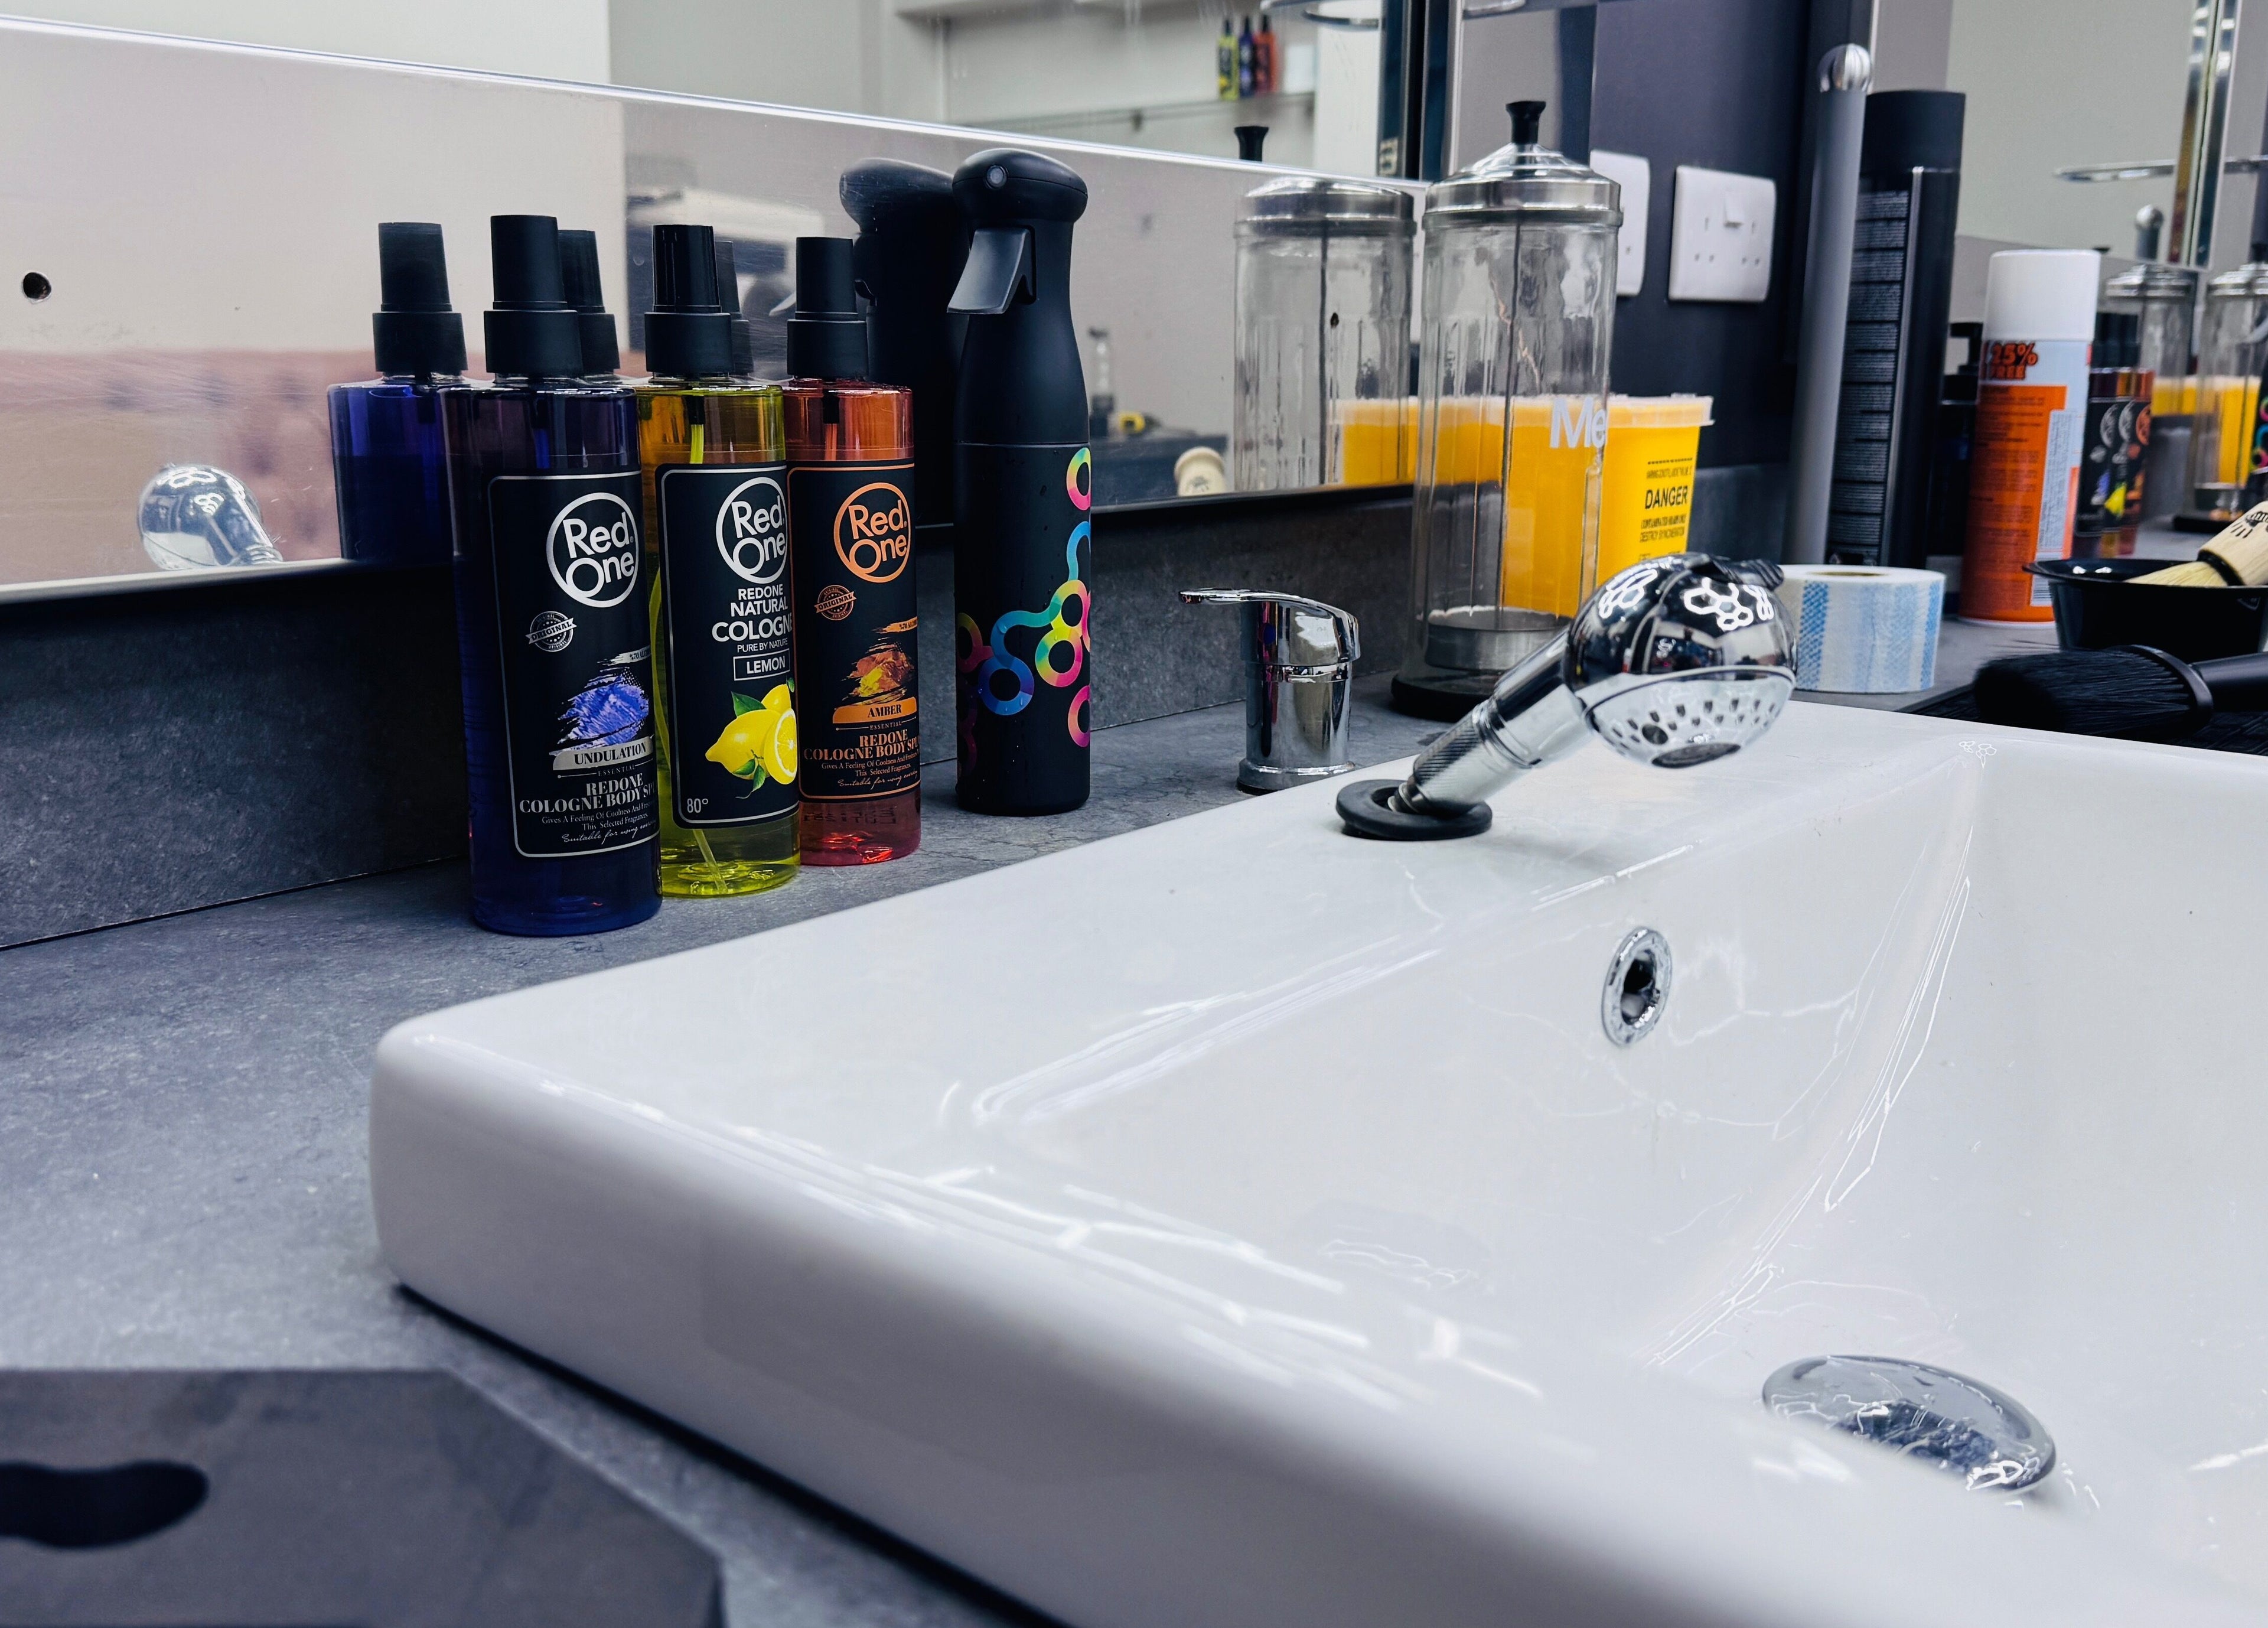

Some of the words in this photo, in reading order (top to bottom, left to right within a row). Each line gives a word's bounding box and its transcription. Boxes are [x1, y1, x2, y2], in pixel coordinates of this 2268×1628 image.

[1645, 486, 1688, 509] DANGER
[731, 495, 783, 538] Red
[848, 499, 904, 539] Red
[563, 512, 630, 558] Red
[732, 532, 786, 575] One
[849, 535, 907, 574] One
[565, 552, 634, 598] One
[738, 584, 783, 600] REDONE
[731, 596, 788, 617] NATURAL
[818, 594, 853, 610] ORIGINAL
[531, 621, 572, 640] ORIGINAL
[737, 643, 758, 653] PURE
[759, 642, 768, 650] BY
[769, 638, 788, 649] NATURE
[747, 656, 785, 674] LEMON
[867, 704, 902, 718] AMBER
[869, 721, 902, 730] ESSENTIAL
[859, 728, 908, 747] REDONE
[574, 742, 646, 765] UNDULATION
[804, 747, 873, 760] COLOGNE
[876, 741, 906, 757] BODY
[598, 764, 636, 776] ESSENTIAL
[845, 761, 866, 770] Feeling
[870, 766, 890, 776] Selected
[586, 773, 643, 796] REDONE
[838, 777, 871, 787] Suitable
[871, 776, 885, 790] for
[520, 796, 602, 813] COLOGNE
[606, 788, 641, 807] BODY
[571, 813, 594, 822] Feeling
[606, 809, 630, 818] Coolness
[582, 823, 597, 831] This
[600, 818, 624, 828] Selected
[562, 831, 602, 842] Suitable
[601, 829, 618, 845] for
